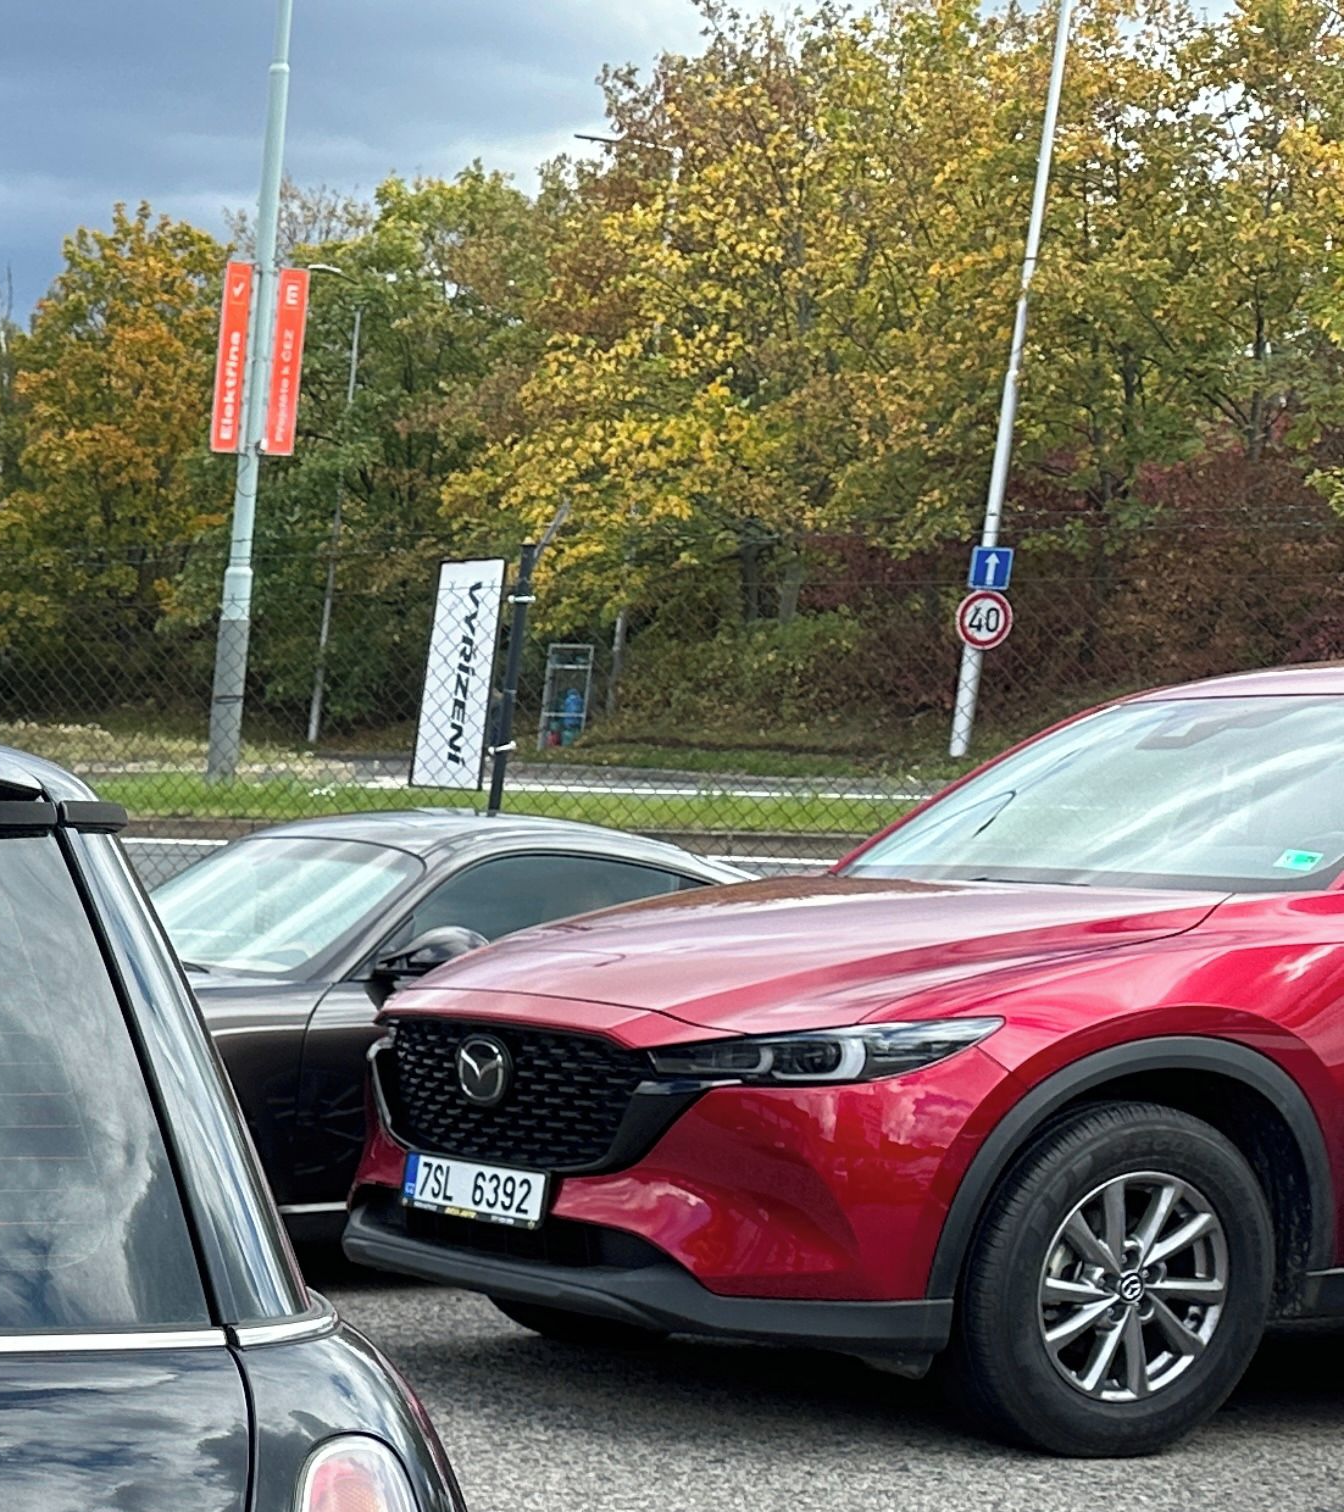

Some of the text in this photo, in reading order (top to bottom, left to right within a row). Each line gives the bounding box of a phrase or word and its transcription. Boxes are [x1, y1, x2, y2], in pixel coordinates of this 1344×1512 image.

[219, 331, 241, 440] Elektřina
[969, 607, 1000, 632] 40
[448, 582, 483, 767] VYŘÍZENÍ
[419, 1161, 453, 1201] 7SL
[472, 1171, 532, 1215] 6392
